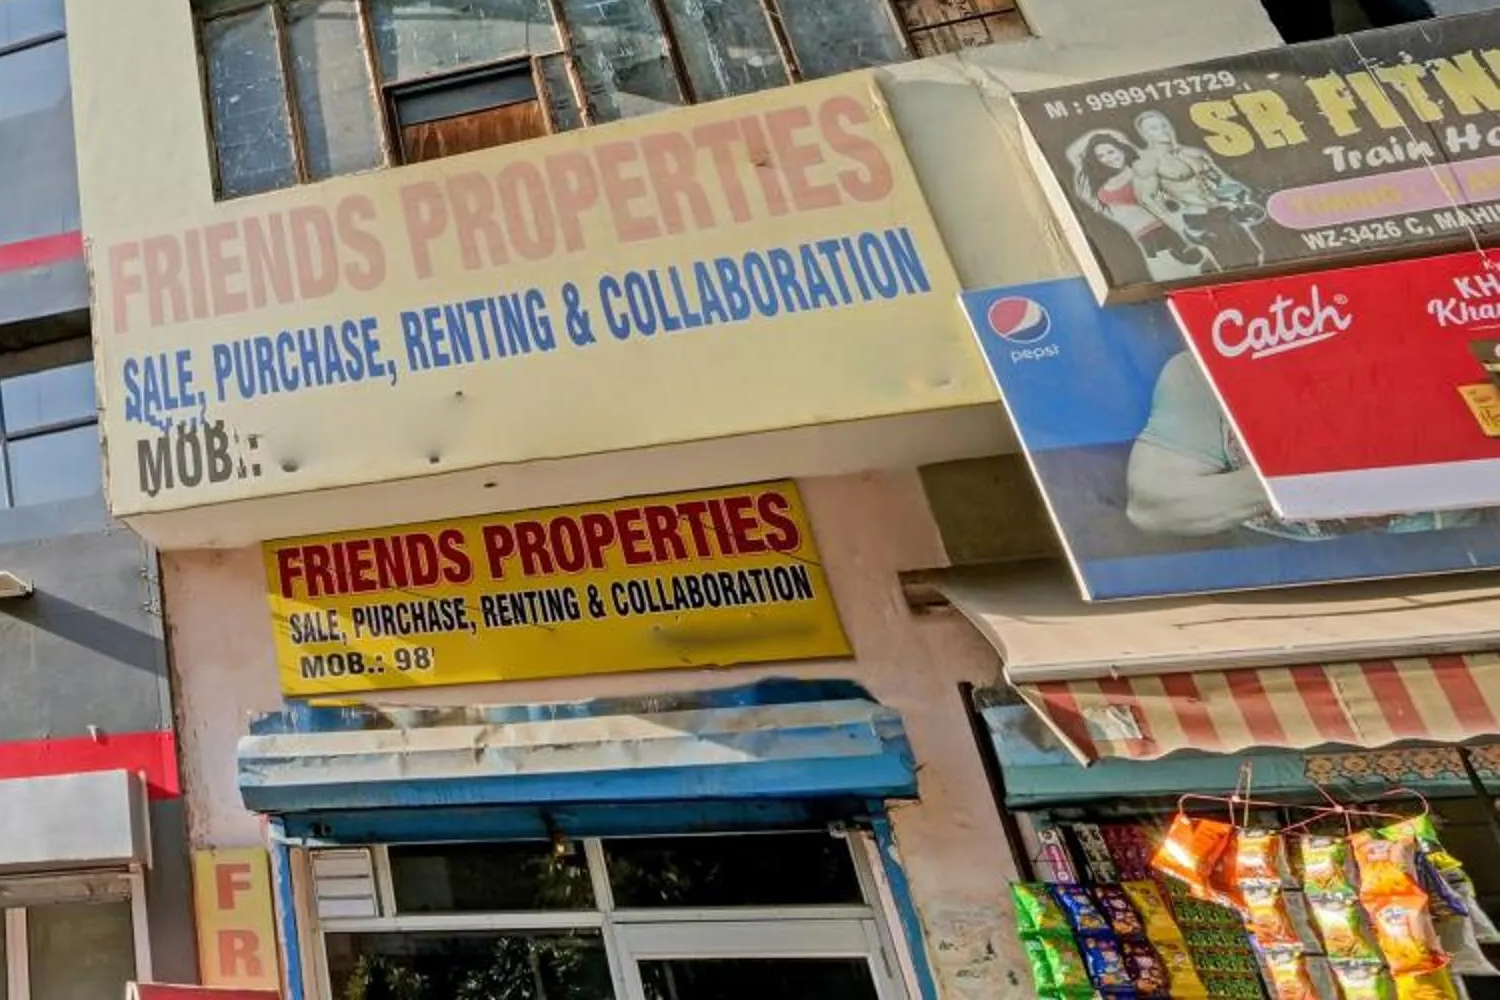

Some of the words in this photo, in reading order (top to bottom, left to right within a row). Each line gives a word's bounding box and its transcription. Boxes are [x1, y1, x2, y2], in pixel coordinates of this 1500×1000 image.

[1045, 100, 1069, 119] M
[1086, 70, 1237, 112] 9999173729
[1189, 89, 1308, 157] SR
[1322, 135, 1435, 172] Train
[108, 194, 386, 334] FRIENDS
[398, 95, 893, 280] PROPERTIES
[1301, 222, 1401, 251] WZ-3426
[123, 349, 206, 420] SALE,
[212, 316, 397, 401] PURCHASE,
[400, 287, 556, 371] RENTING
[561, 281, 596, 346] &
[599, 226, 931, 341] COLLABORATION
[1010, 344, 1061, 364] pepsi
[1212, 285, 1352, 360] Catch
[278, 529, 471, 600] FRIENDS
[482, 491, 799, 580] PROPERTIES
[290, 609, 347, 645] SALE,
[352, 598, 476, 638] PURCHASE,
[480, 586, 580, 628] RENTING
[587, 584, 607, 618] &
[611, 565, 814, 616] COLLABORATION
[300, 651, 384, 679] MOB.:
